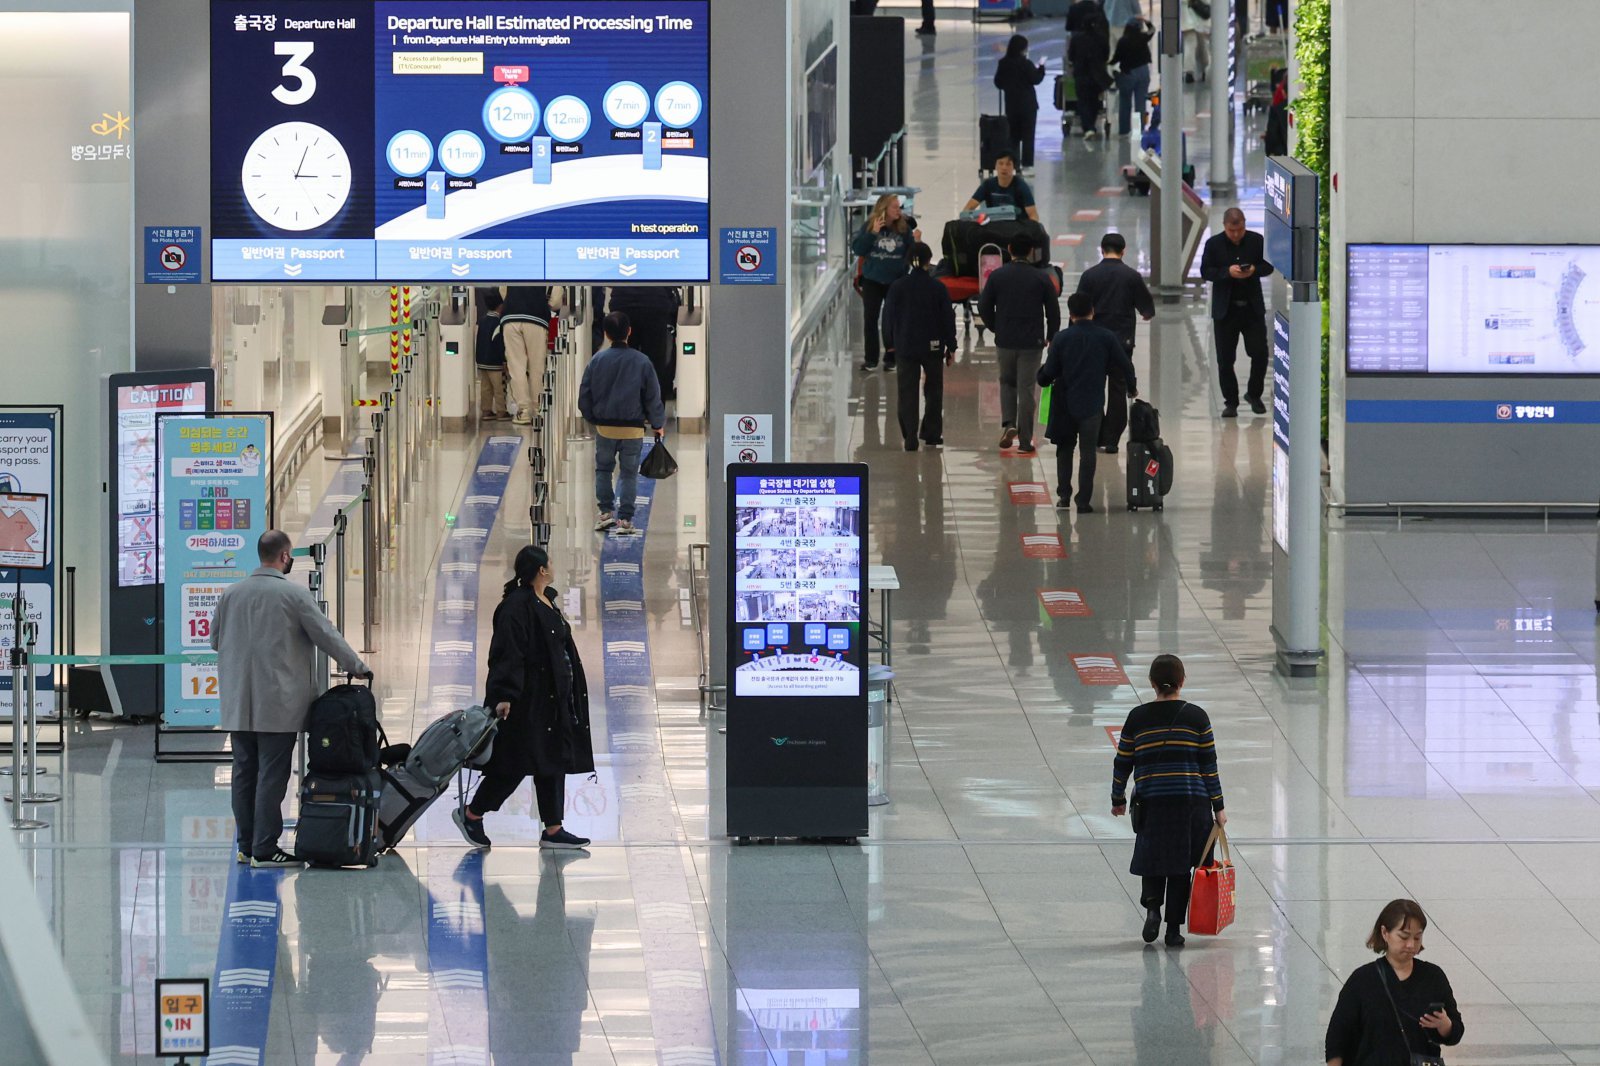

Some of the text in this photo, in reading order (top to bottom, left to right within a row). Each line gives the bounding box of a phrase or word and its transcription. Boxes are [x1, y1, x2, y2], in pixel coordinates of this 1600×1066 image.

[233, 14, 277, 32] 출국장
[284, 18, 356, 31] Departure Hall
[387, 15, 693, 32] Departure Hall Estimated Processing Time
[403, 35, 570, 46] from Departure Hall Entry to Immigration
[271, 41, 317, 106] 3
[614, 98, 640, 110] 7min
[666, 98, 692, 110] 7min
[493, 106, 533, 121] 12min
[552, 113, 585, 124] 12min
[647, 130, 656, 142] 2
[395, 147, 428, 159] 11min
[446, 147, 479, 159] 11min
[536, 144, 546, 156] 3
[430, 180, 440, 192] 4
[152, 230, 194, 238] 사진촬영금지
[631, 224, 698, 234] In test operation
[728, 230, 769, 238] 사진촬영금지
[241, 247, 285, 260] 일반여권
[290, 248, 345, 261] Passport
[409, 247, 452, 260] 일반여권
[458, 248, 512, 261] Passport
[576, 247, 620, 260] 일반여권
[626, 248, 680, 261] Passport
[130, 388, 193, 404] CAUTION
[1515, 406, 1554, 418] 공항안내
[180, 426, 249, 438] 의심되는 순간
[26, 436, 48, 444] your
[30, 446, 48, 454] and
[191, 442, 238, 453] 멈추세요!
[15, 458, 41, 466] pass.
[759, 478, 836, 488] 출국장별 대기열 상황
[201, 486, 229, 498] CARD
[780, 497, 816, 506] 2번 출국장
[190, 538, 240, 548] 기억하세요!
[780, 539, 816, 548] 4번 출국장
[780, 580, 816, 589] 5번 출국장
[175, 1018, 192, 1031] IN
